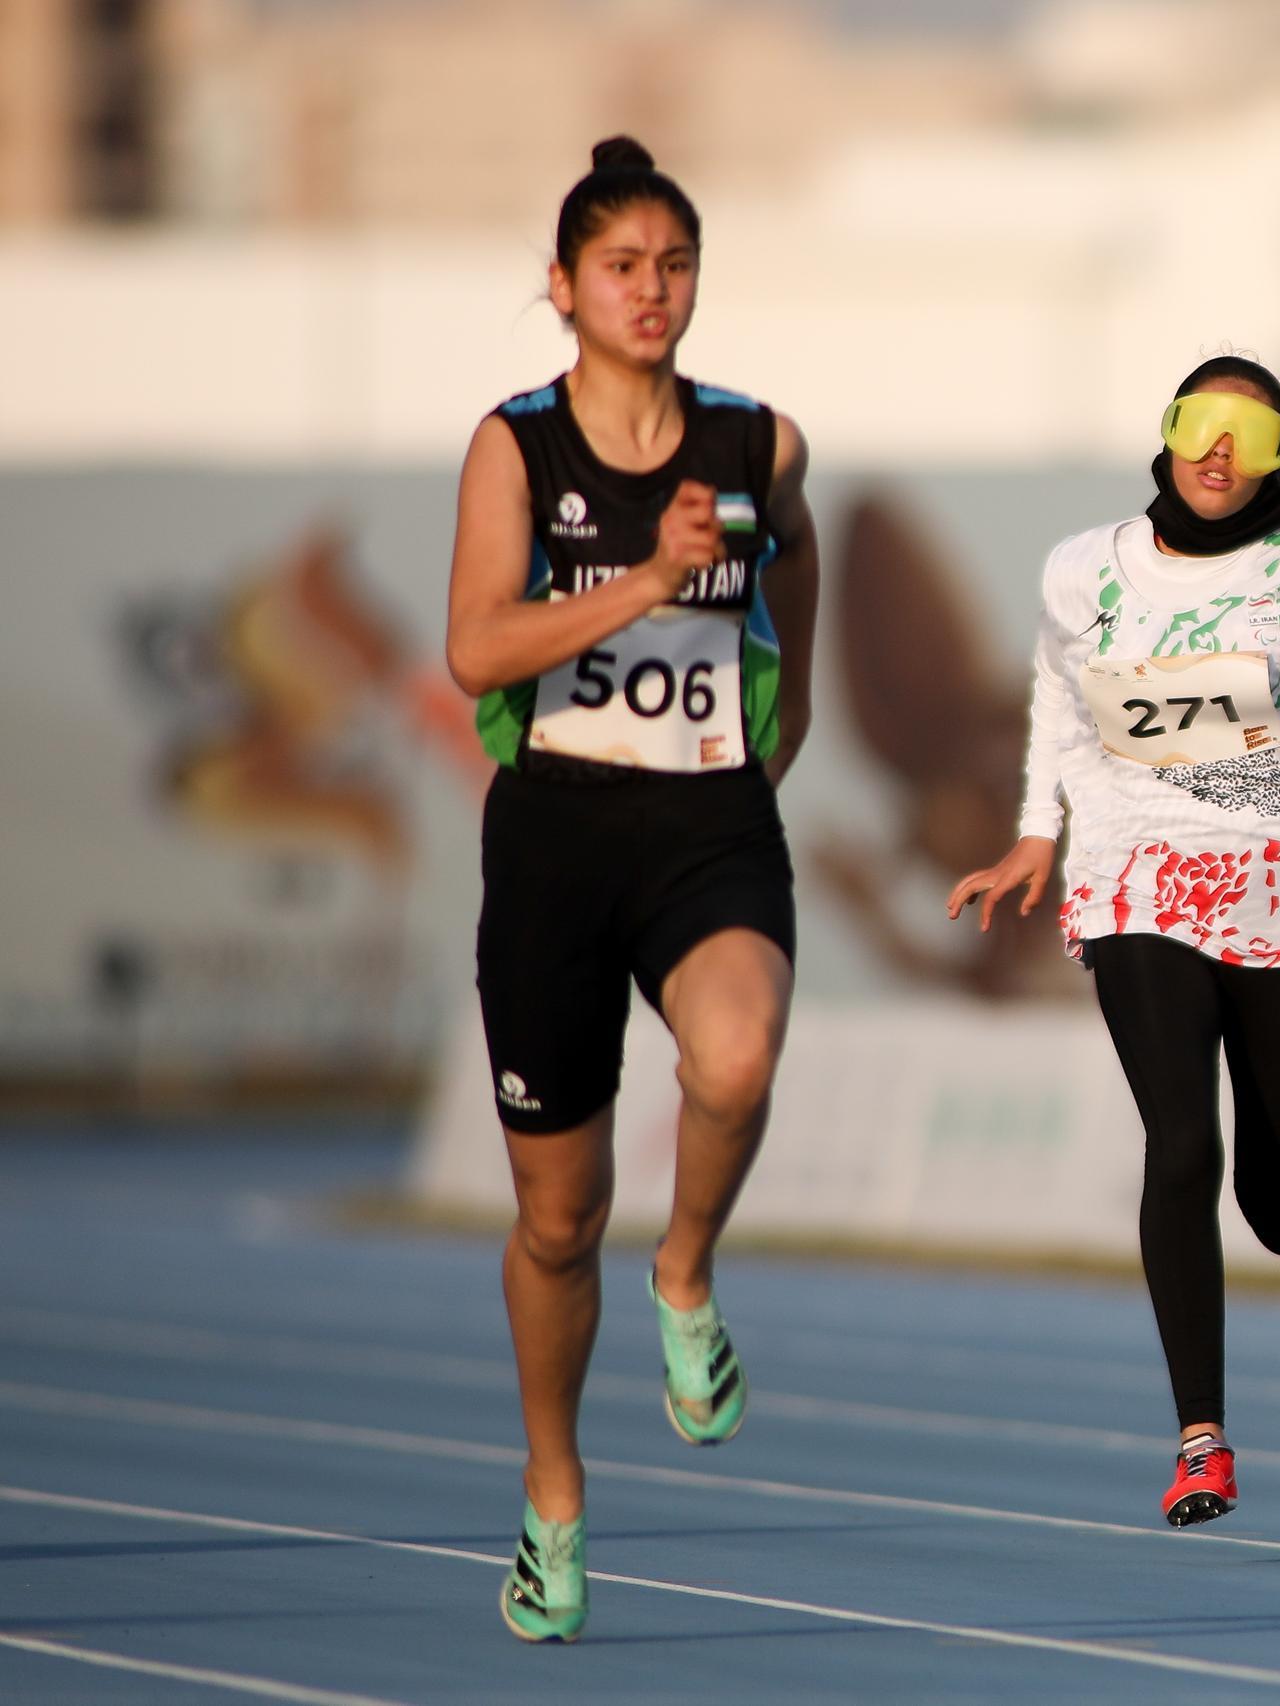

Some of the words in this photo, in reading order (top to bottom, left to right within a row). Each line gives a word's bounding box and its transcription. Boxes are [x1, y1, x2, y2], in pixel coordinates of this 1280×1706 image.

[569, 650, 716, 723] 506
[1121, 694, 1242, 739] 271
[1244, 734, 1257, 743] to
